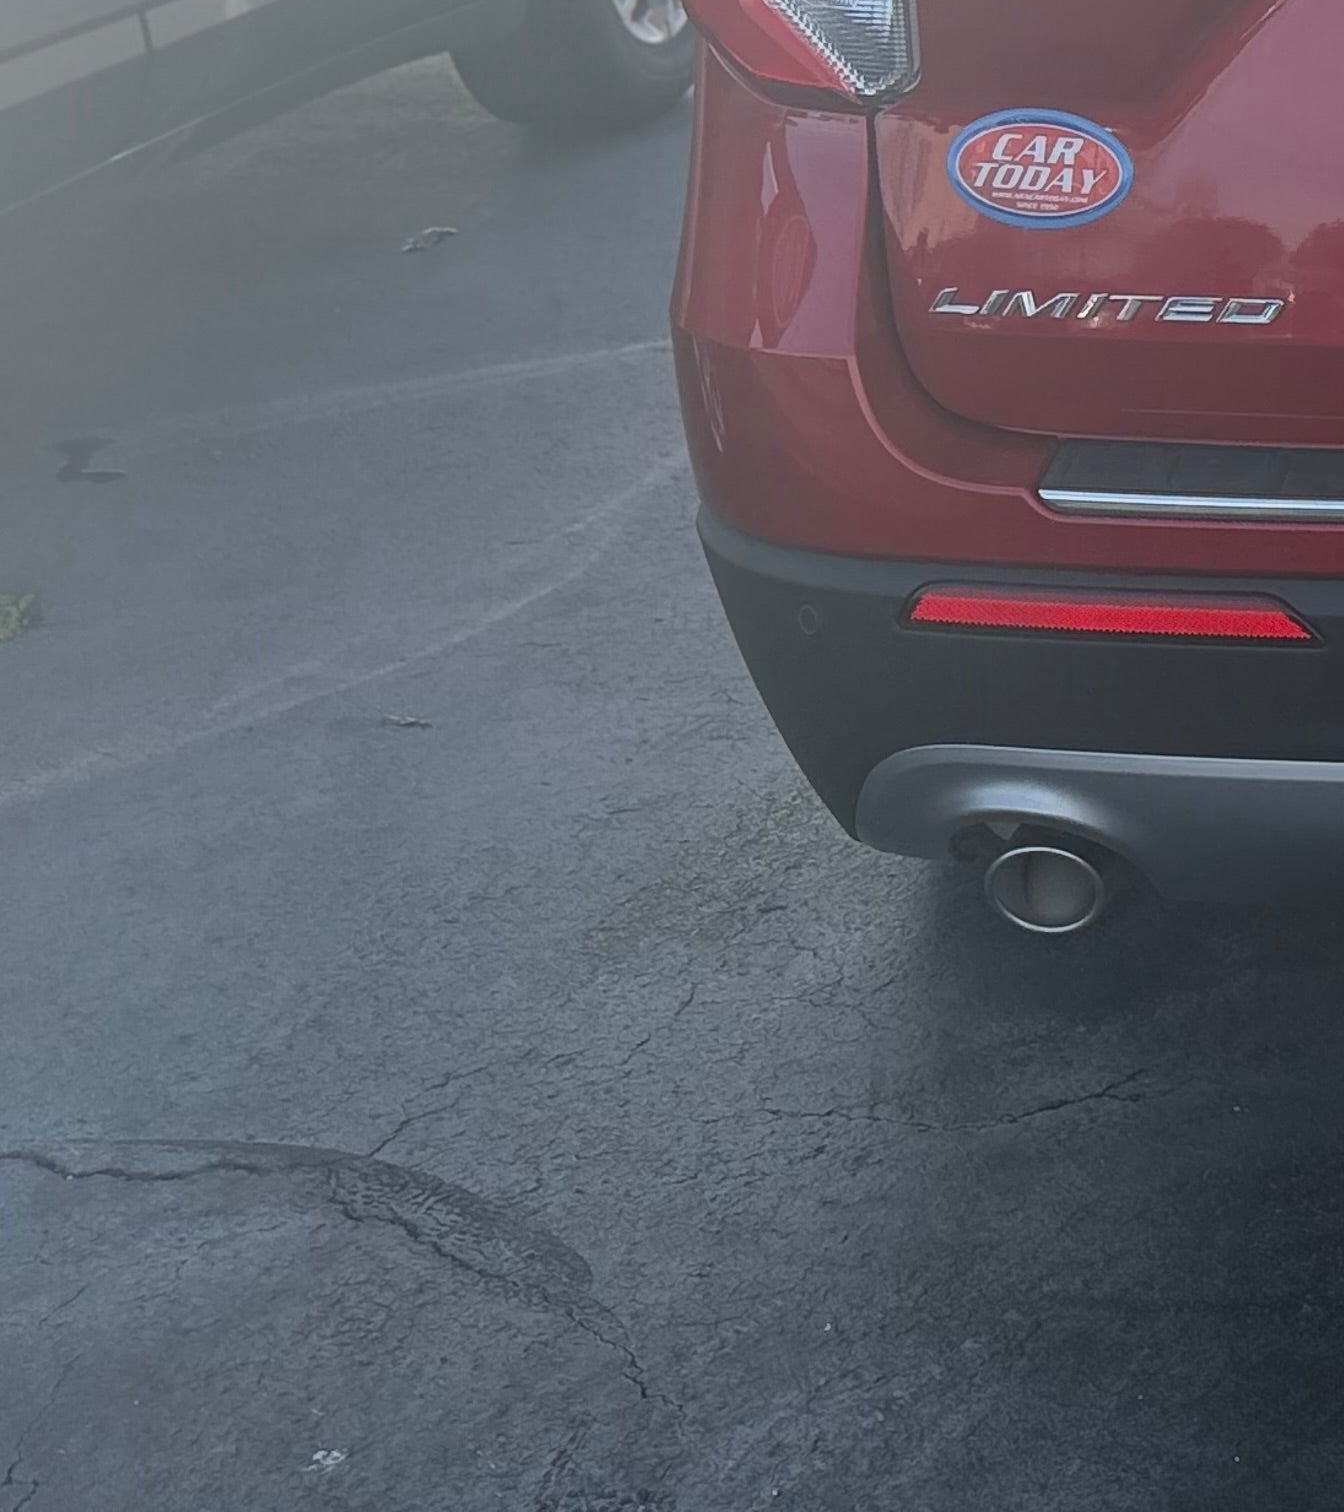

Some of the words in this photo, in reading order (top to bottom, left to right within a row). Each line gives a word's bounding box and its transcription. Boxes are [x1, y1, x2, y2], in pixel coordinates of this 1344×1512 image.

[991, 132, 1085, 165] CAR
[971, 161, 1108, 195] TODAY
[928, 286, 1286, 325] LIMITED
